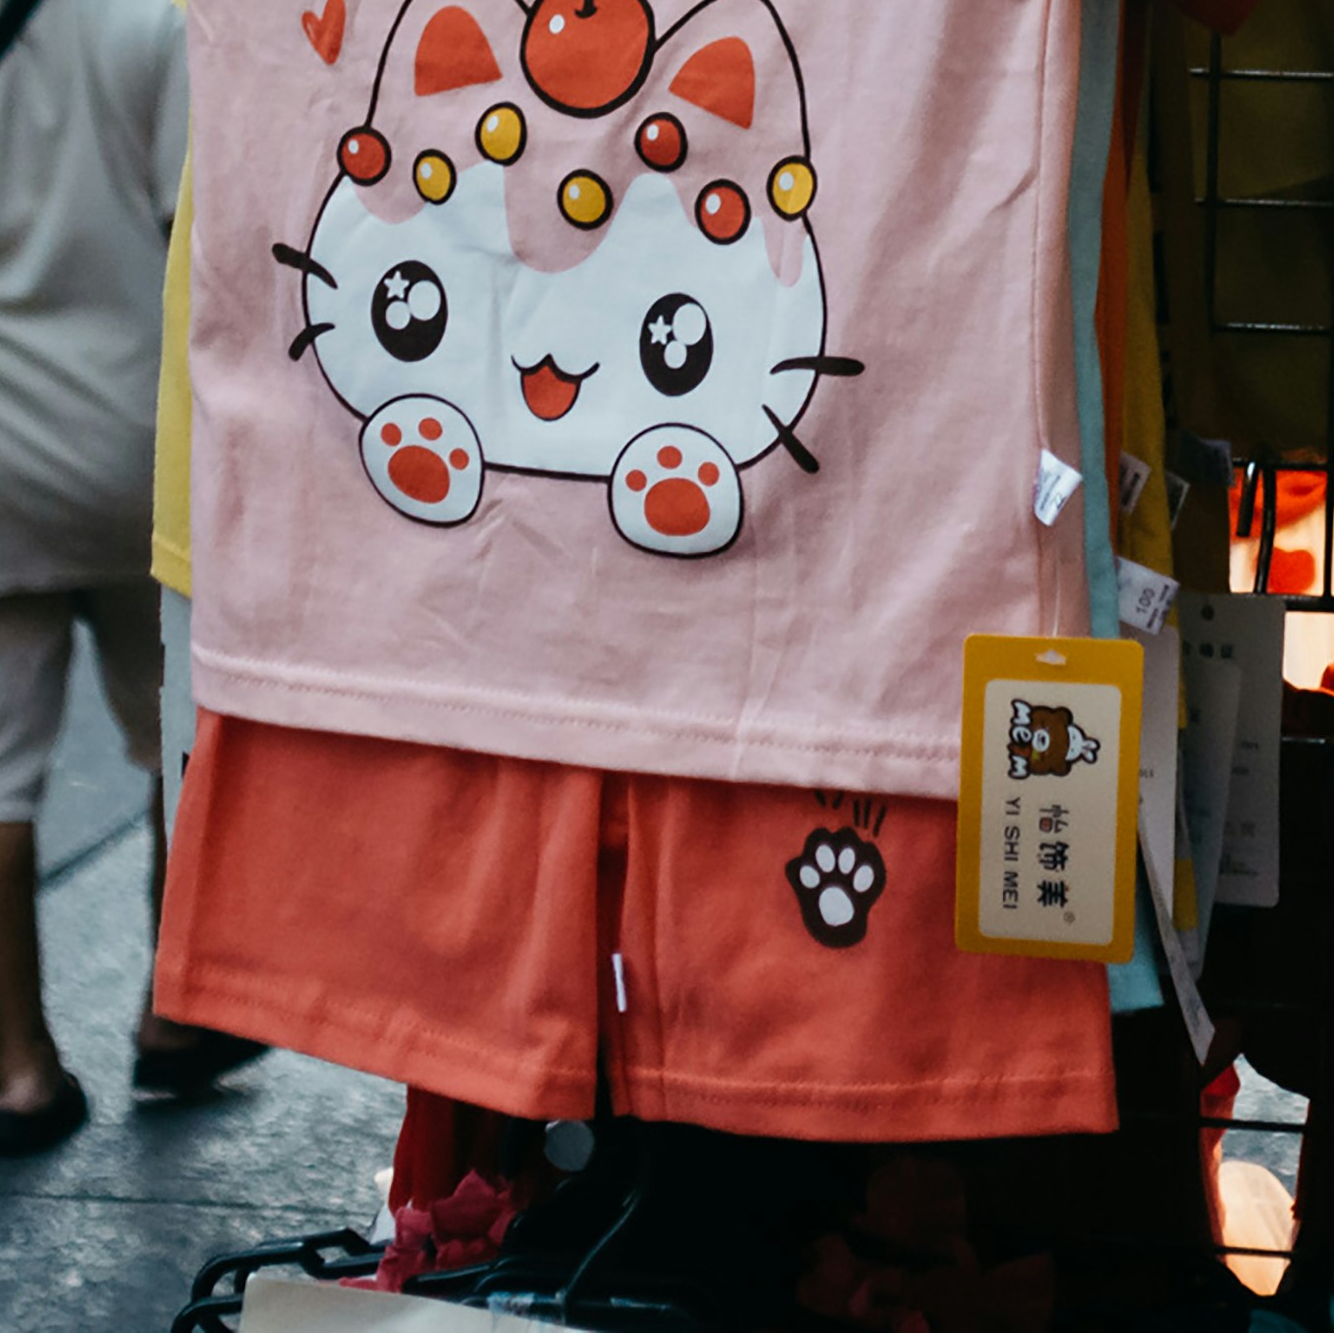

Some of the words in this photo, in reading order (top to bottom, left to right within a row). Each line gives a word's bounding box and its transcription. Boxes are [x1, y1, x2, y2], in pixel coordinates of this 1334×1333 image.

[1005, 796, 1022, 816] YI
[1004, 825, 1020, 862] SHI
[1002, 871, 1019, 910] MEI
